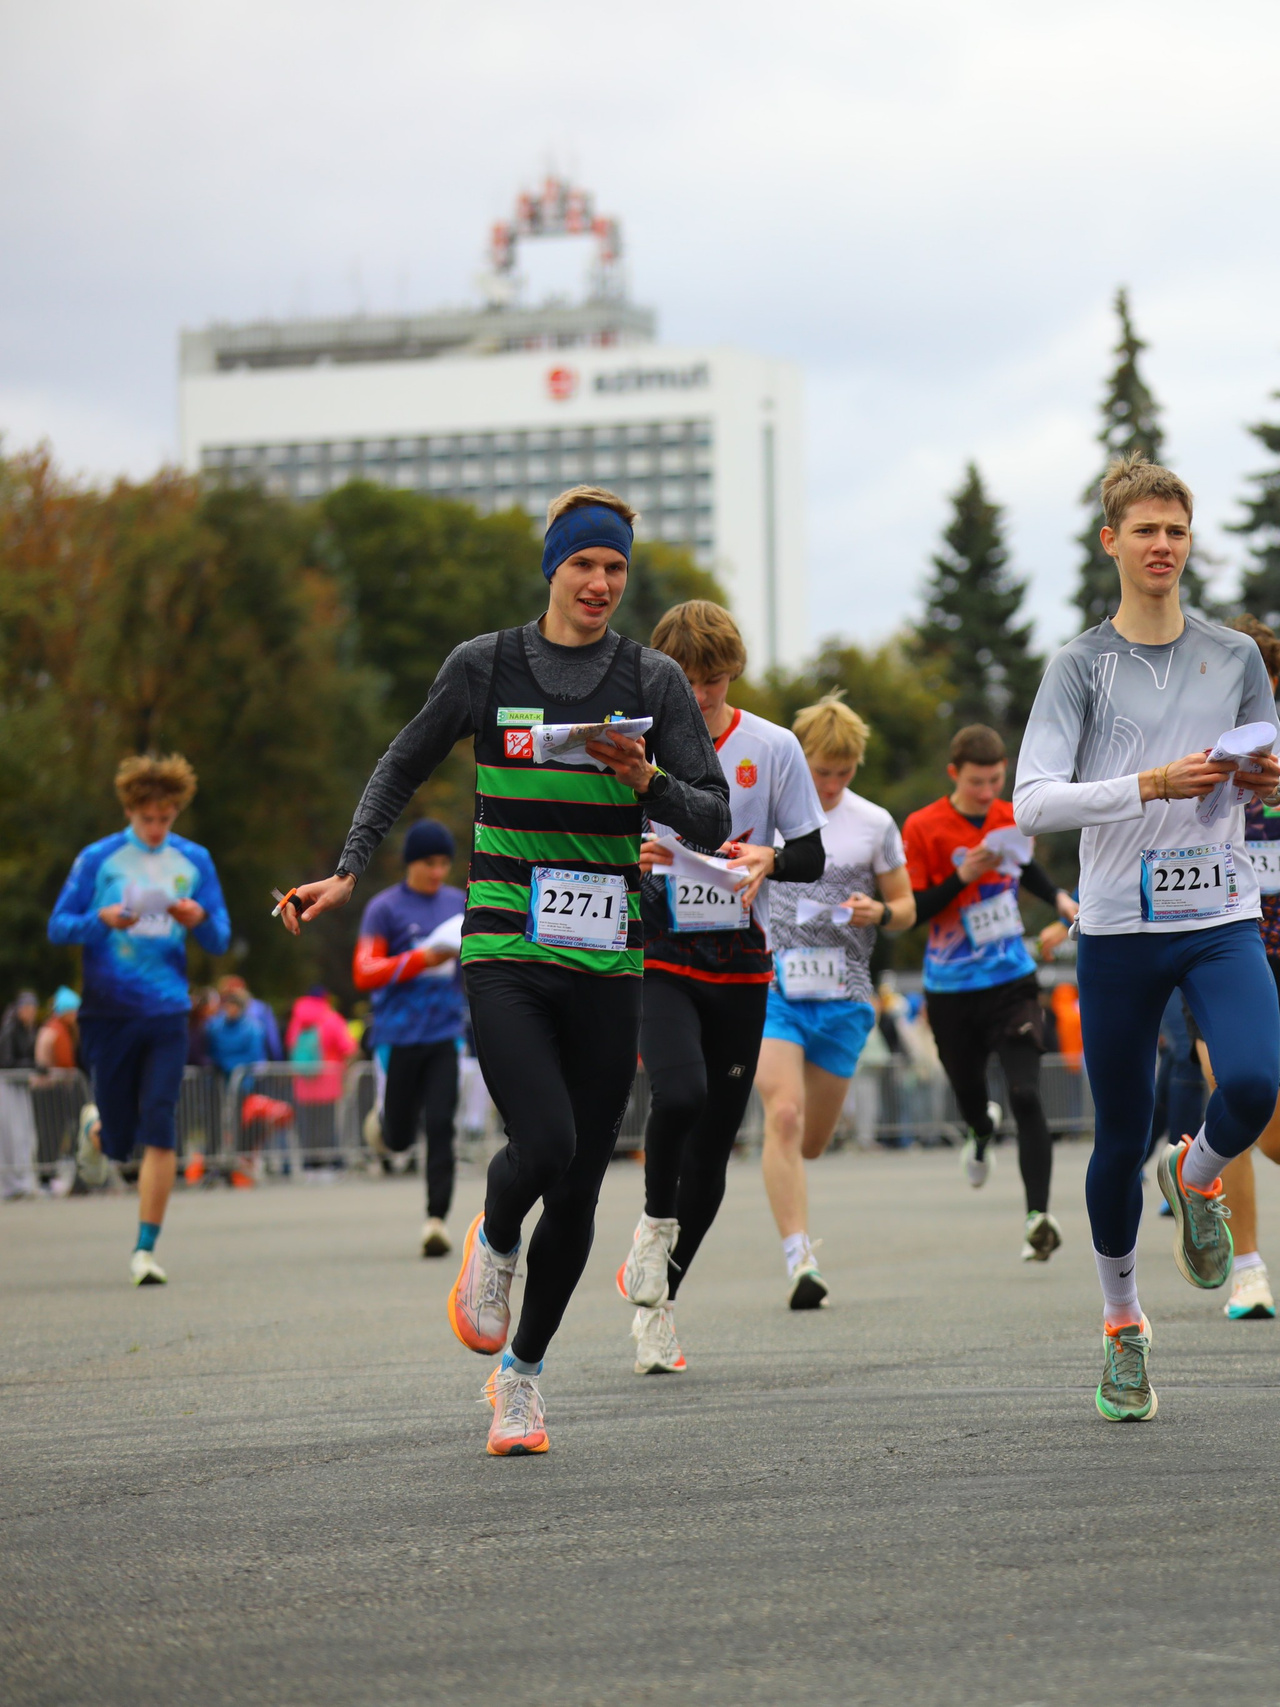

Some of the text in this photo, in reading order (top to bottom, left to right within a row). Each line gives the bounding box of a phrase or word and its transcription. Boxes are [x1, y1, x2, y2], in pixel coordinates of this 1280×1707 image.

[509, 713, 541, 721] NARAT-K
[1154, 864, 1222, 891] 222.1
[541, 889, 613, 919] 227.1
[787, 960, 834, 978] 233.1
